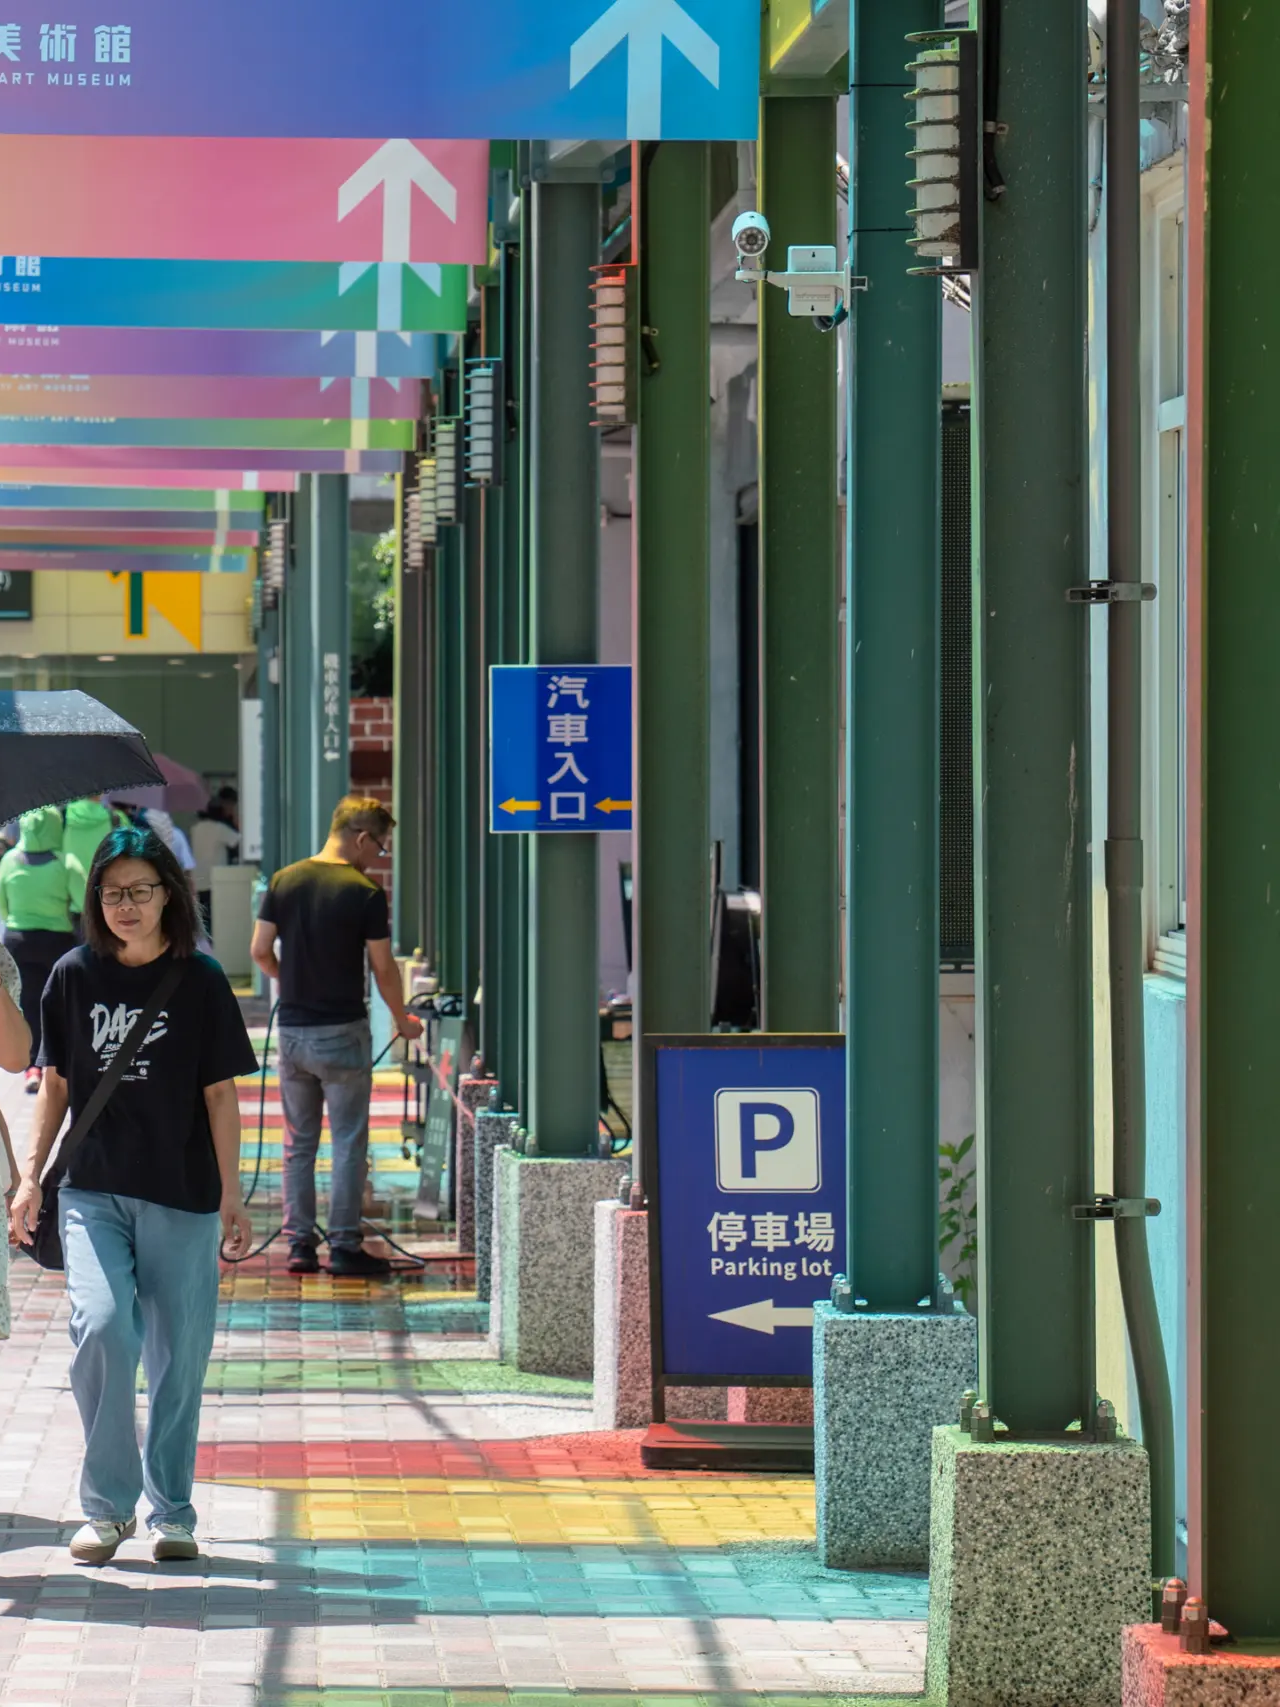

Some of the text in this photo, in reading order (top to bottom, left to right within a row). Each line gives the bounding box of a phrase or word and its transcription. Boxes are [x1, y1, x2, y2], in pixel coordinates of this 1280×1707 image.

[47, 74, 132, 86] MUSEUM
[547, 675, 590, 821] 汽車入口
[739, 1102, 795, 1179] P
[707, 1212, 835, 1252] 停車場
[711, 1257, 832, 1281] Parking lot
